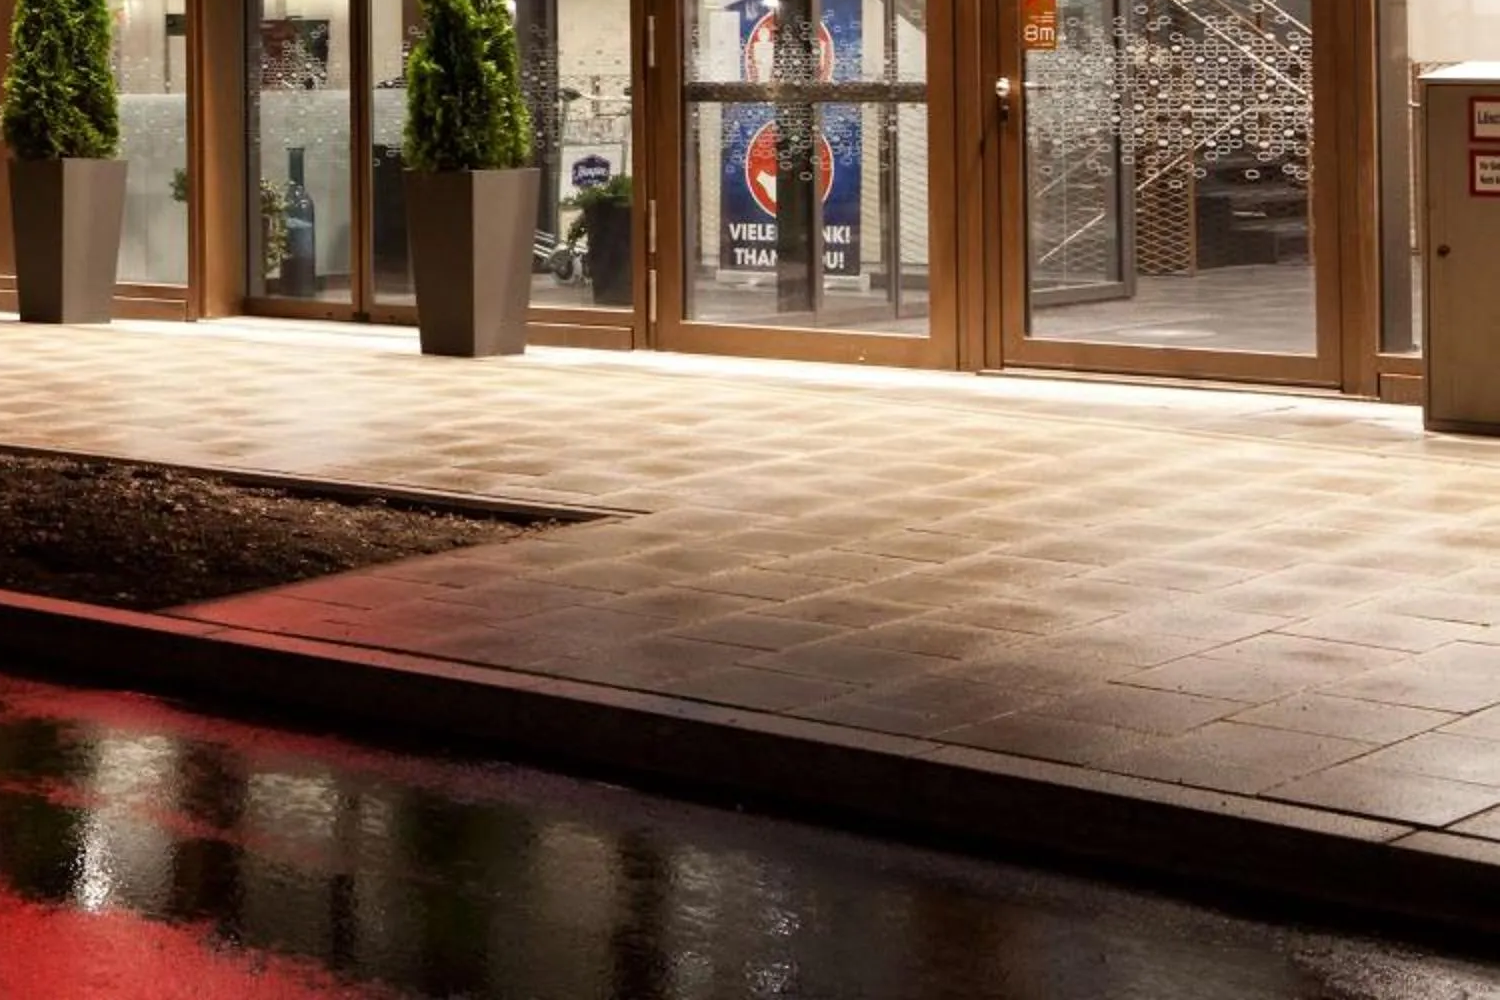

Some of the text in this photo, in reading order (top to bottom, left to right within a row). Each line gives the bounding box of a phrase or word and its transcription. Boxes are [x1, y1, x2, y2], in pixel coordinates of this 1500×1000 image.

[728, 222, 851, 245] VIELE NK!
[733, 247, 779, 267] THAN
